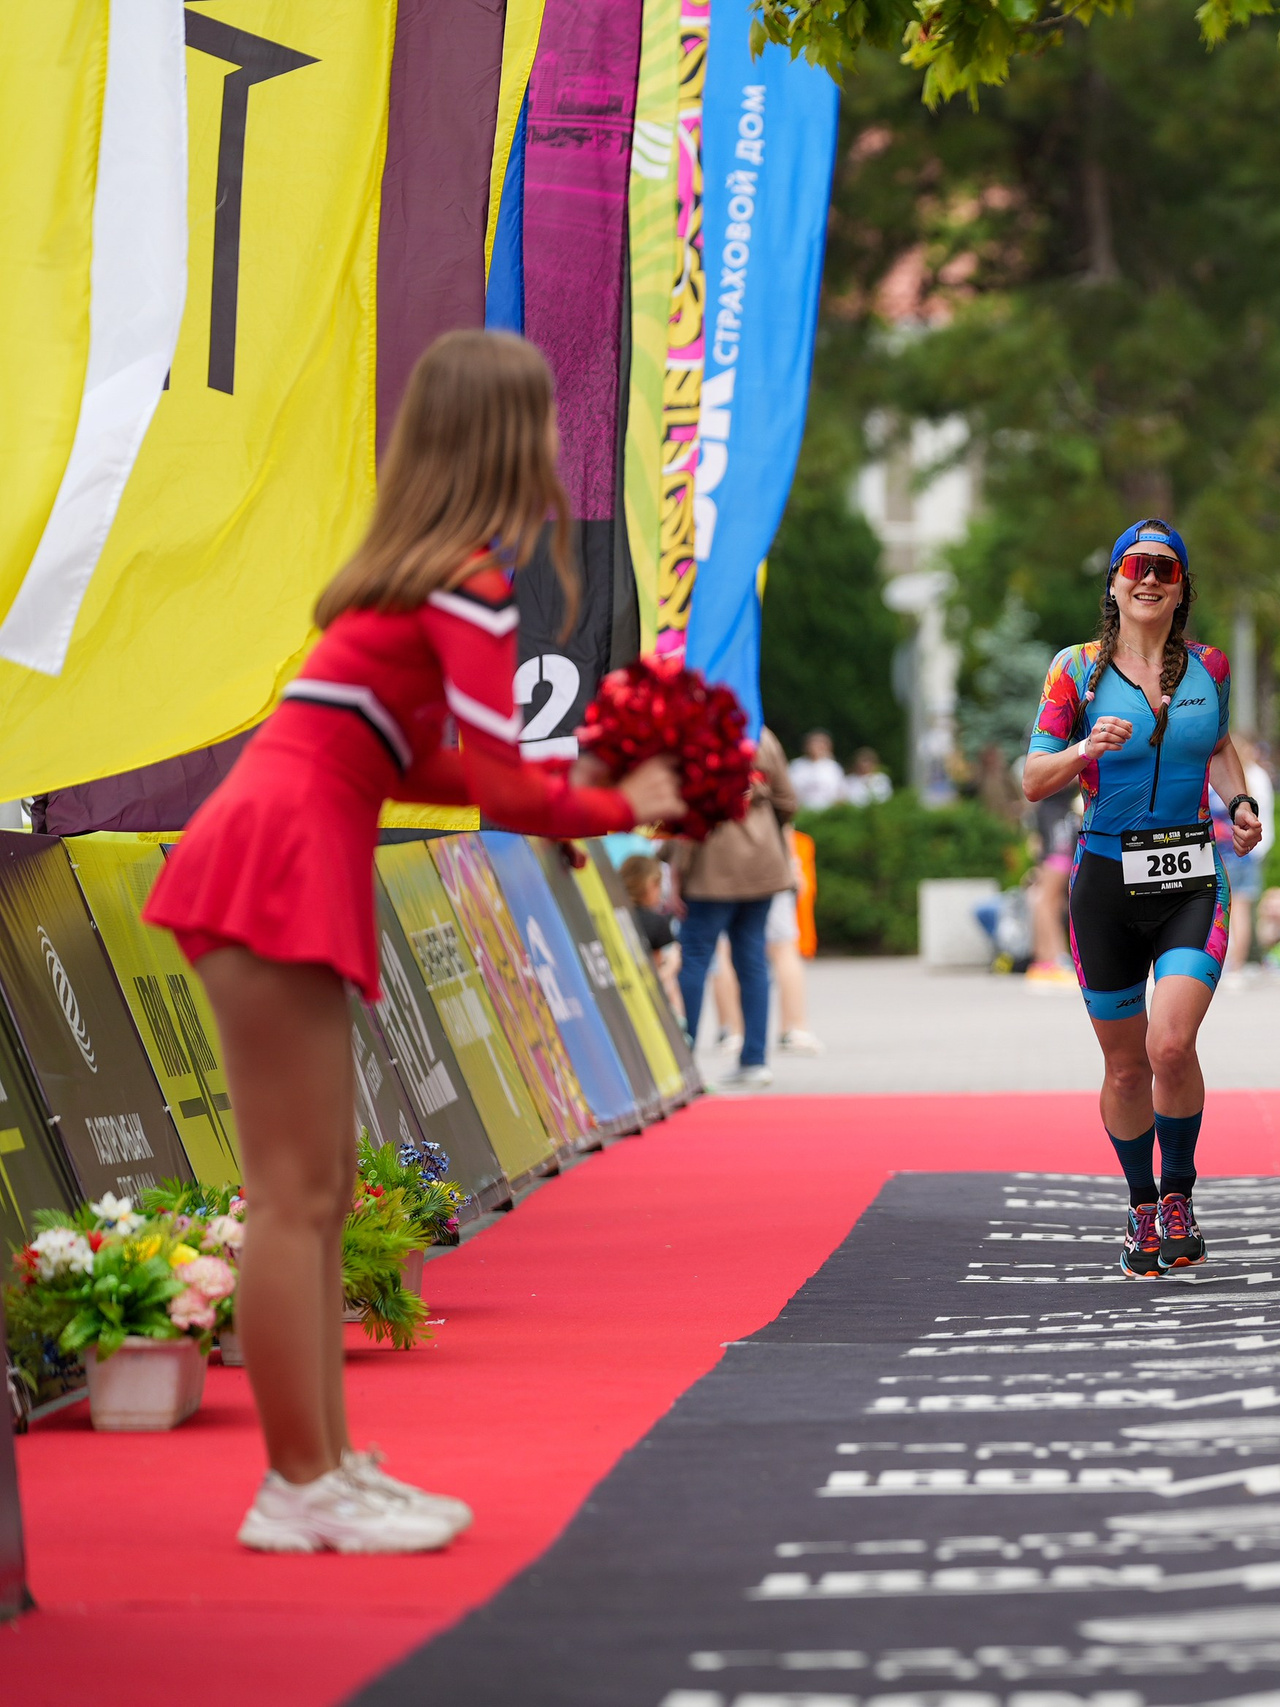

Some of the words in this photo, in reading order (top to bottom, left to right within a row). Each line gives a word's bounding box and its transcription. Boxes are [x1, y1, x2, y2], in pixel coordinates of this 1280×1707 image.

[734, 84, 767, 166] ДОМ
[712, 170, 759, 367] СТРАХОВОЙ
[1152, 832, 1165, 841] IRON
[1168, 831, 1181, 839] STAR
[1146, 851, 1192, 877] 286
[1160, 881, 1183, 890] AMINA
[133, 974, 192, 1077] IRON
[924, 1320, 1182, 1338] IRON
[872, 1388, 1176, 1411] IRON
[826, 1466, 1173, 1490] IRON
